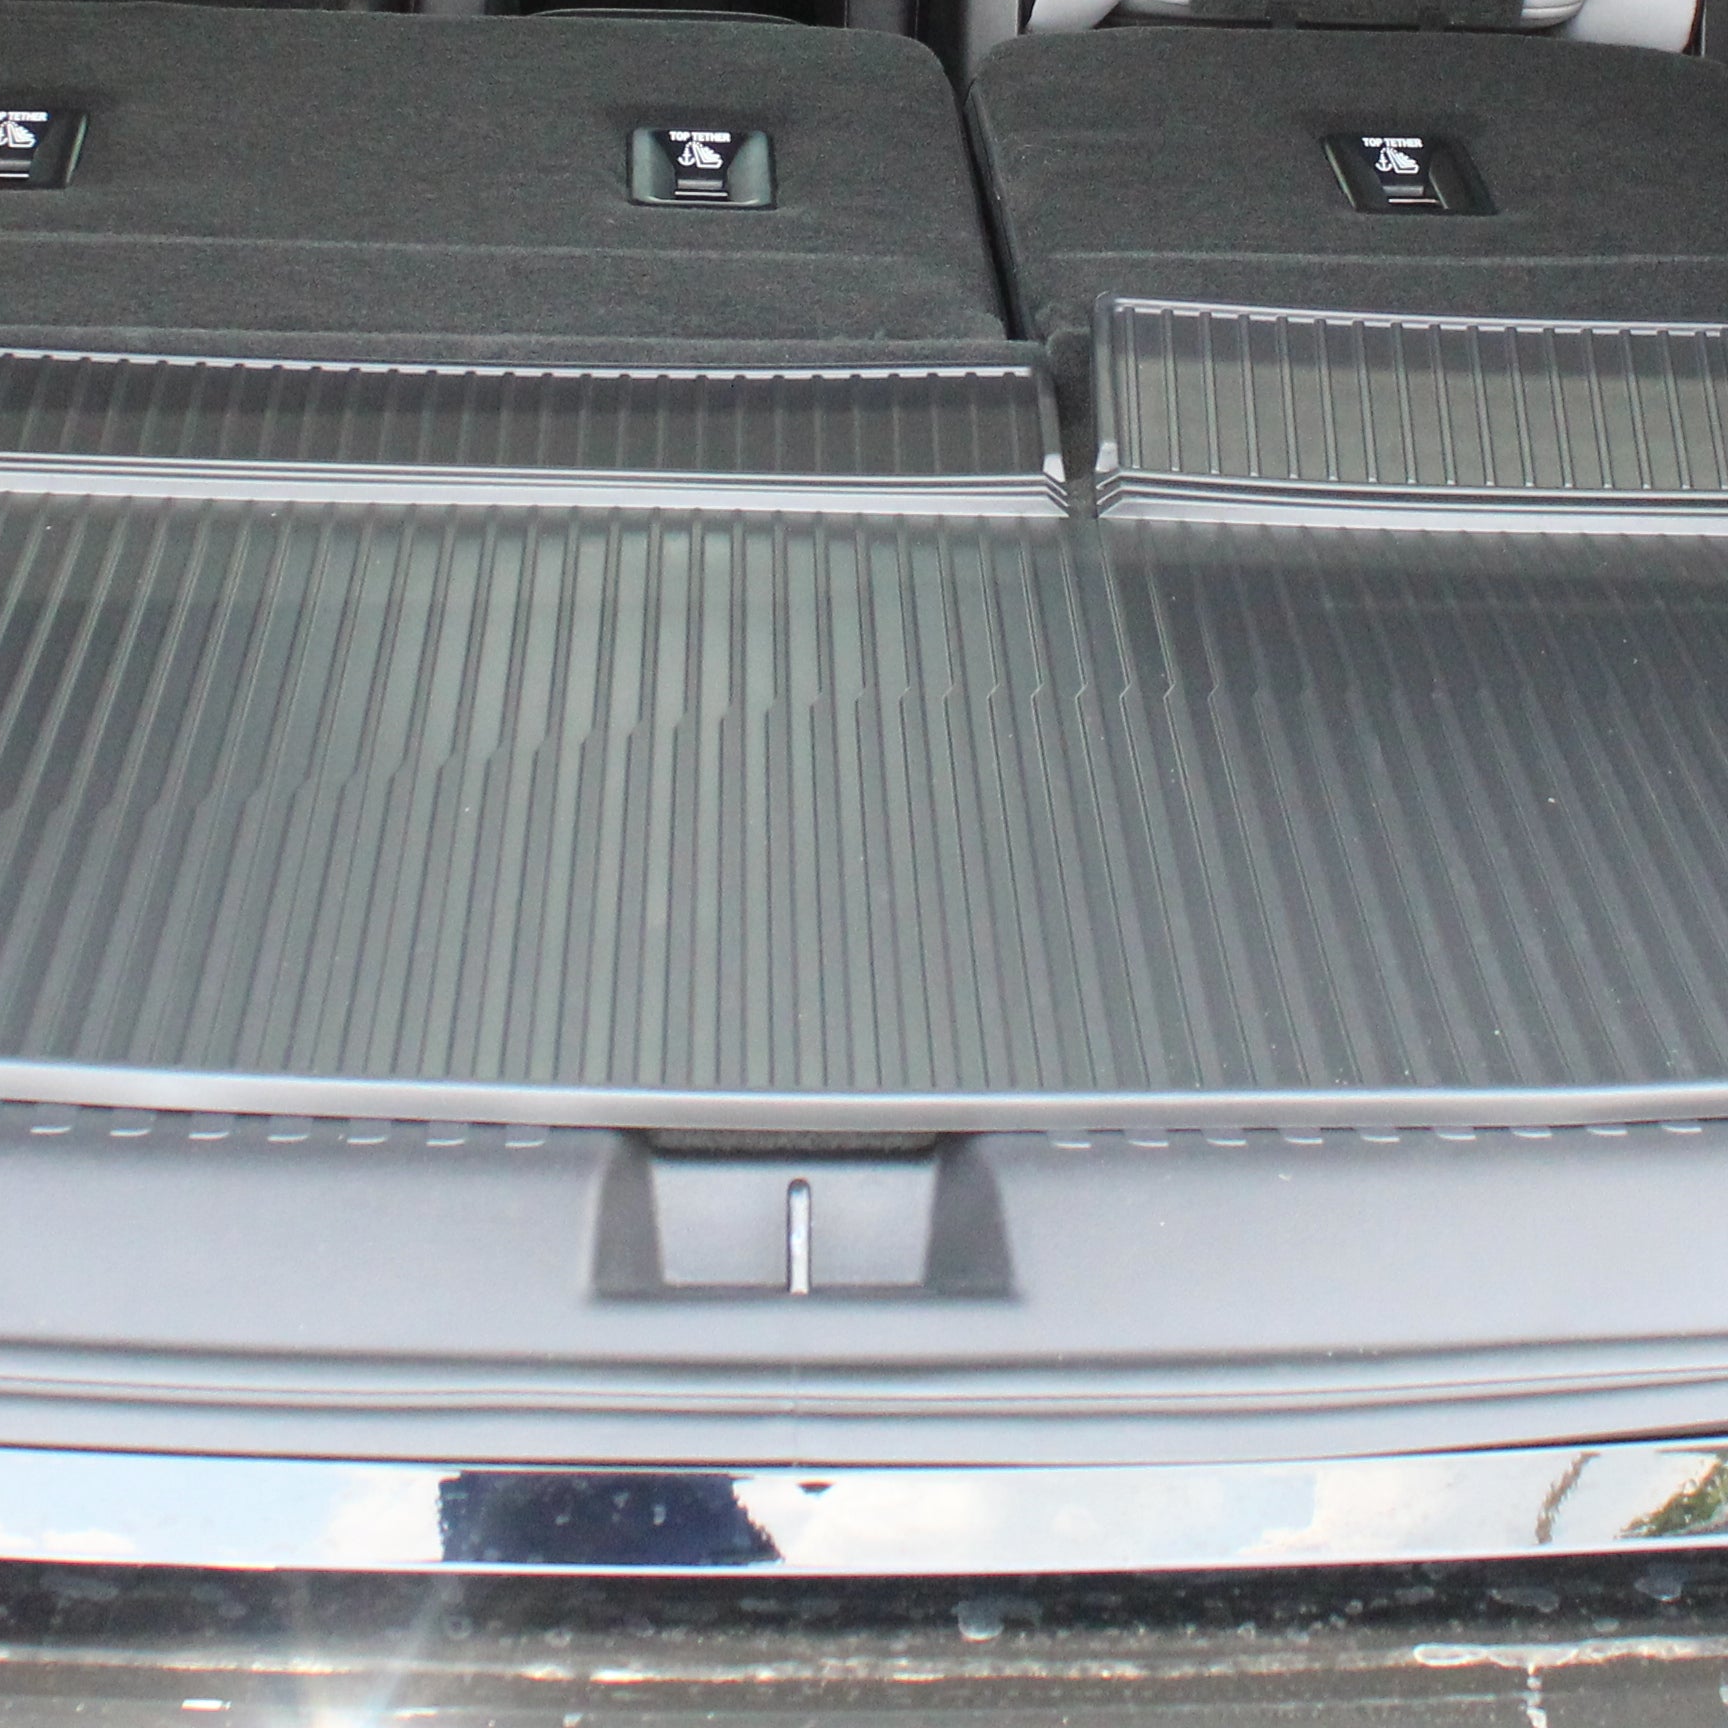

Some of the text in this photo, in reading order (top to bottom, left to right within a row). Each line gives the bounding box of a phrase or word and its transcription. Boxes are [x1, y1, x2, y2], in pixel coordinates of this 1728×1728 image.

[7, 111, 48, 122] TETHER
[669, 131, 731, 142] TOP TETHER
[1362, 137, 1423, 148] TOP TETHER
